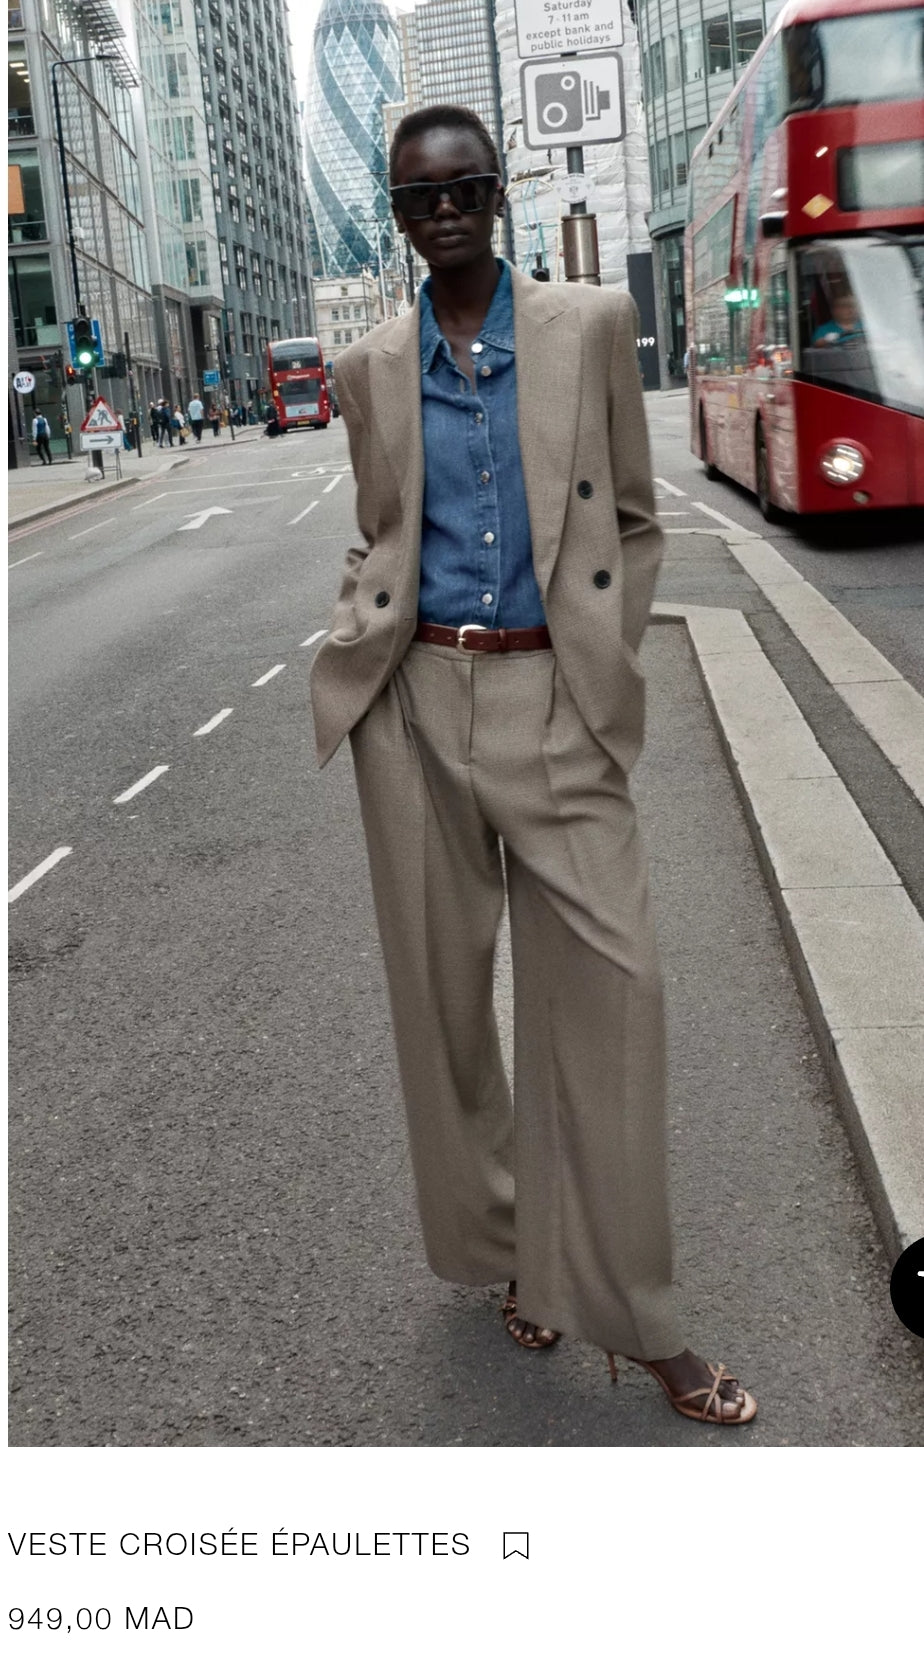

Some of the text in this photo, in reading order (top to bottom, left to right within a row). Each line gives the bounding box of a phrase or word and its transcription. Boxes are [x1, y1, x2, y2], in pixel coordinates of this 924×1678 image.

[543, 0, 593, 12] Saturday
[526, 20, 614, 40] except bank and
[531, 34, 611, 52] public holidays
[636, 336, 655, 347] 199
